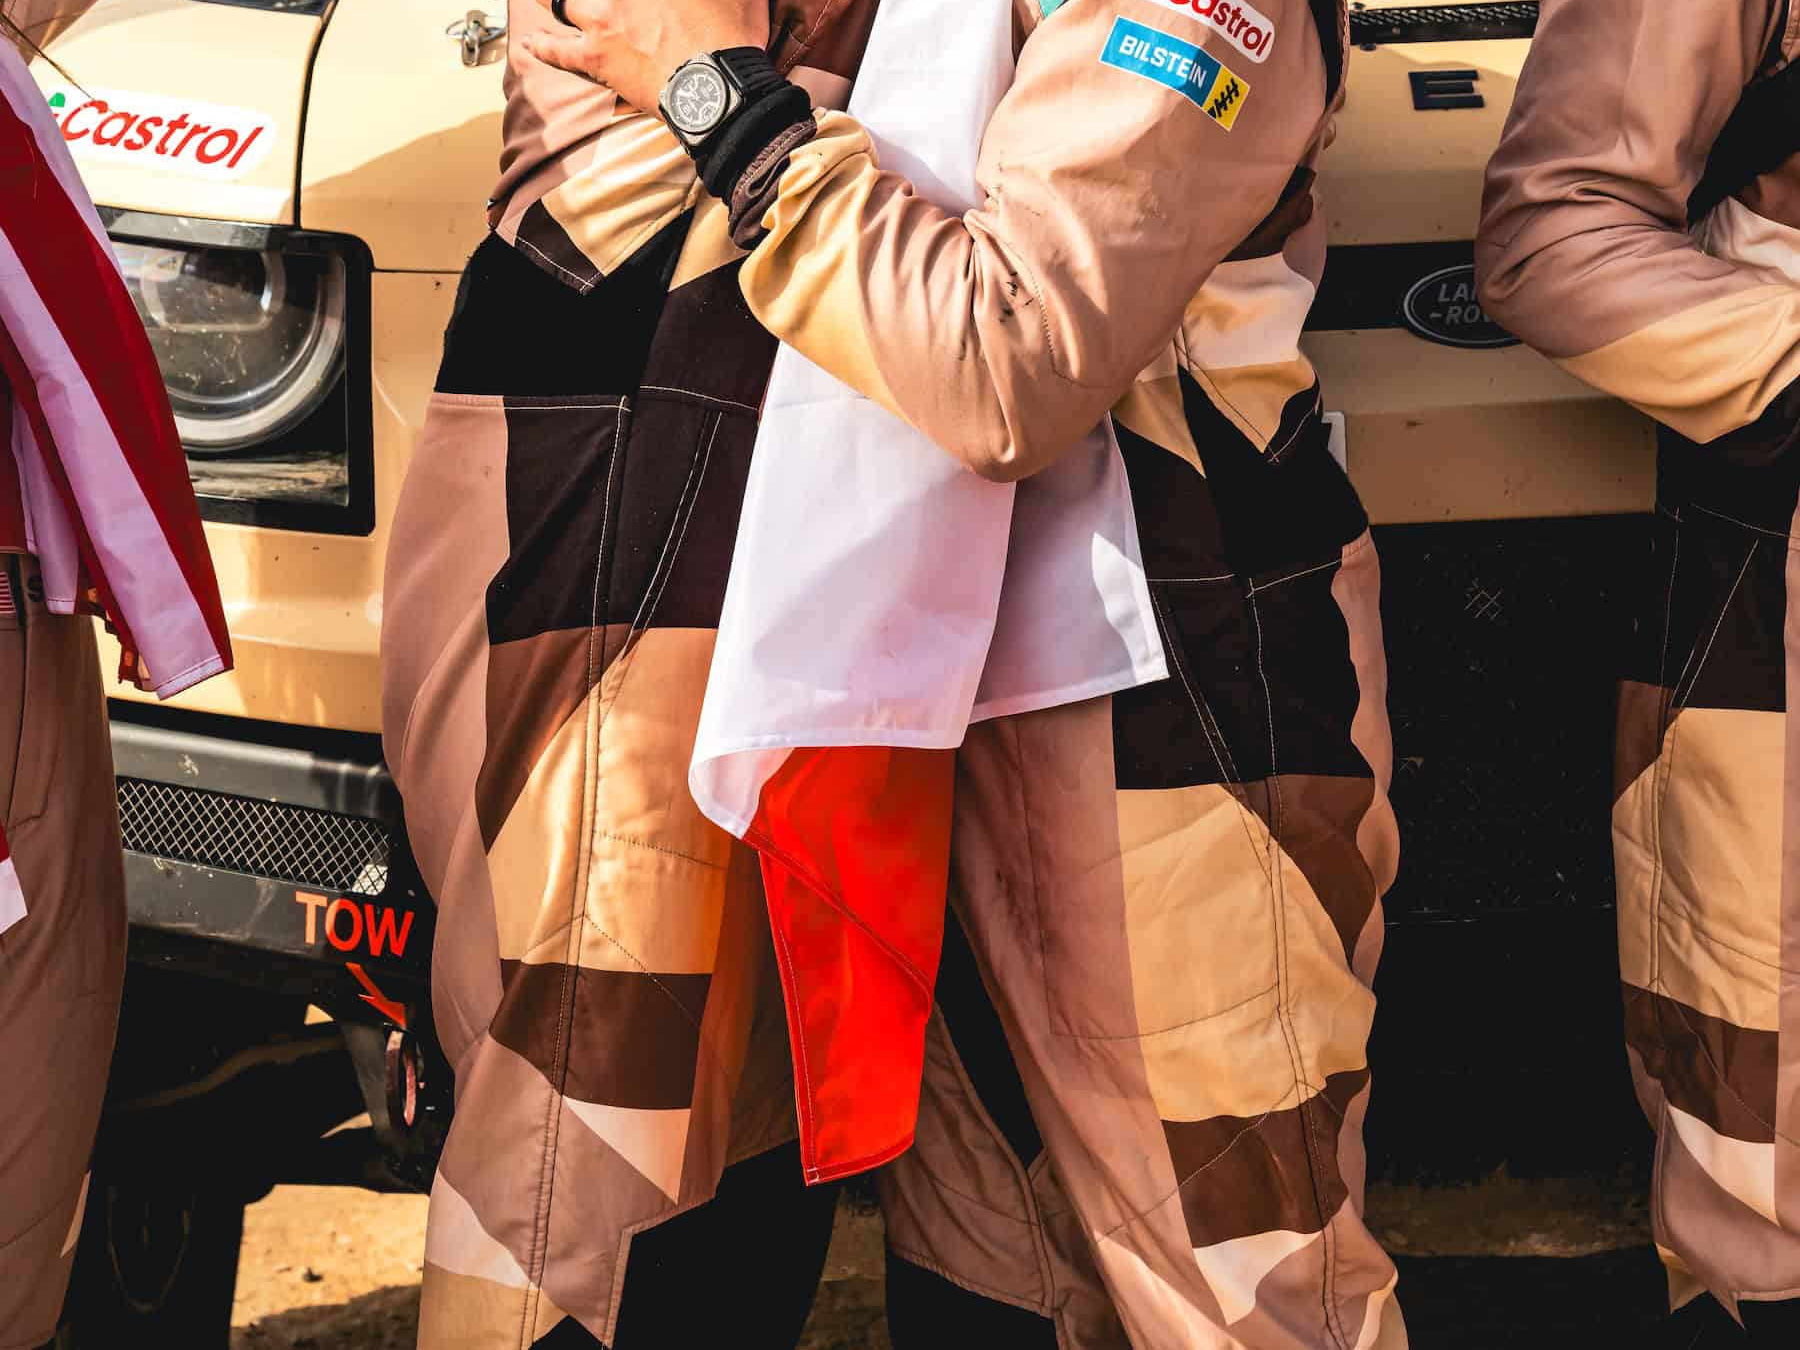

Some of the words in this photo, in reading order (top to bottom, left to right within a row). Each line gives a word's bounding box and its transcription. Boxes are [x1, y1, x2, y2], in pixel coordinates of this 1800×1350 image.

[1119, 34, 1208, 88] BILSTEIN
[1408, 69, 1485, 111] E
[60, 99, 264, 169] Castrol
[295, 890, 415, 958] TOW
